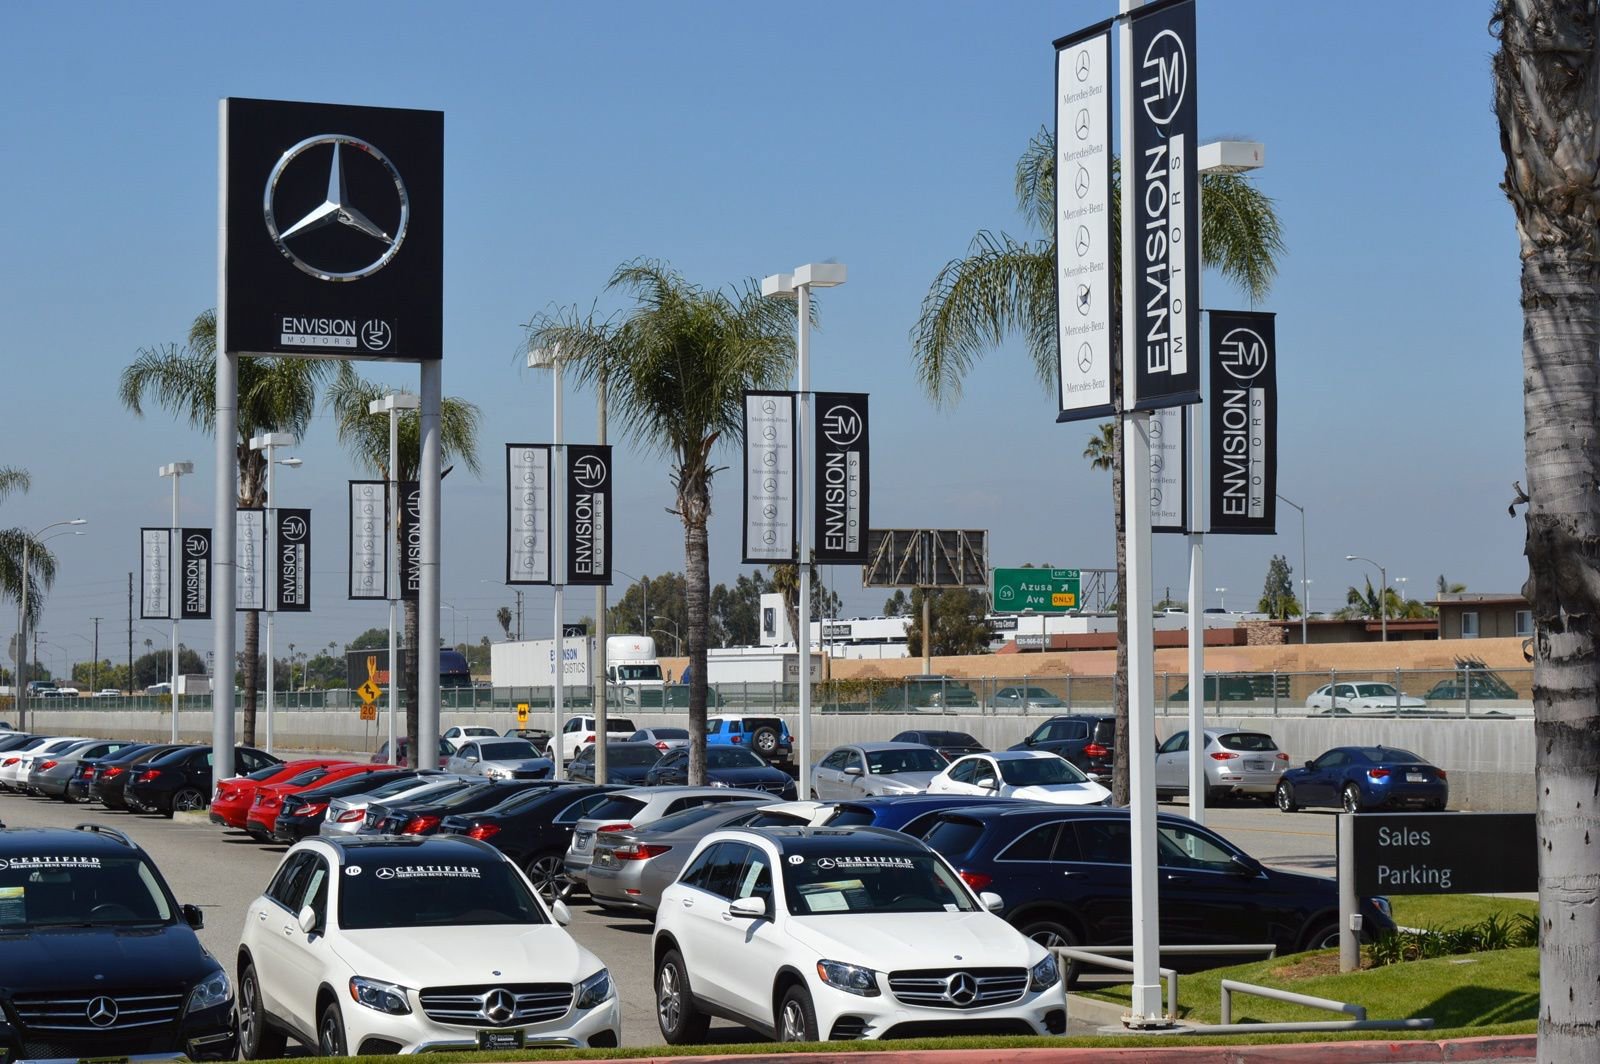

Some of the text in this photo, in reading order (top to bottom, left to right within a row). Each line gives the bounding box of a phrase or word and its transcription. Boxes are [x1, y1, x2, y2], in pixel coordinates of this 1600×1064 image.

[1063, 84, 1103, 105] Mercedes-Benz
[1145, 144, 1169, 374] ENVISION
[1171, 156, 1183, 354] MOTORS
[282, 317, 356, 336] ENVISION
[287, 336, 351, 345] MOTORS
[1066, 379, 1106, 393] Mercedes-Benz
[1222, 389, 1247, 515] ENVISION
[1252, 399, 1262, 507] MOTORS
[825, 452, 845, 550] ENVISION
[849, 460, 857, 544] MOTORS
[575, 494, 592, 574] ENVISION
[408, 522, 421, 591] ENVISION
[283, 544, 296, 604] ENVISION
[186, 559, 199, 612] ENVISION
[1002, 590, 1012, 598] 39
[1020, 582, 1052, 591] Azusa
[1026, 595, 1044, 604] Ave
[550, 648, 578, 661] ENSON
[363, 706, 374, 715] 20
[1378, 826, 1431, 847] Sales
[9, 856, 100, 864] CERTIFIED
[395, 865, 479, 873] CERTIFIED
[835, 856, 912, 864] CERTIFIED
[1377, 864, 1452, 889] Parking
